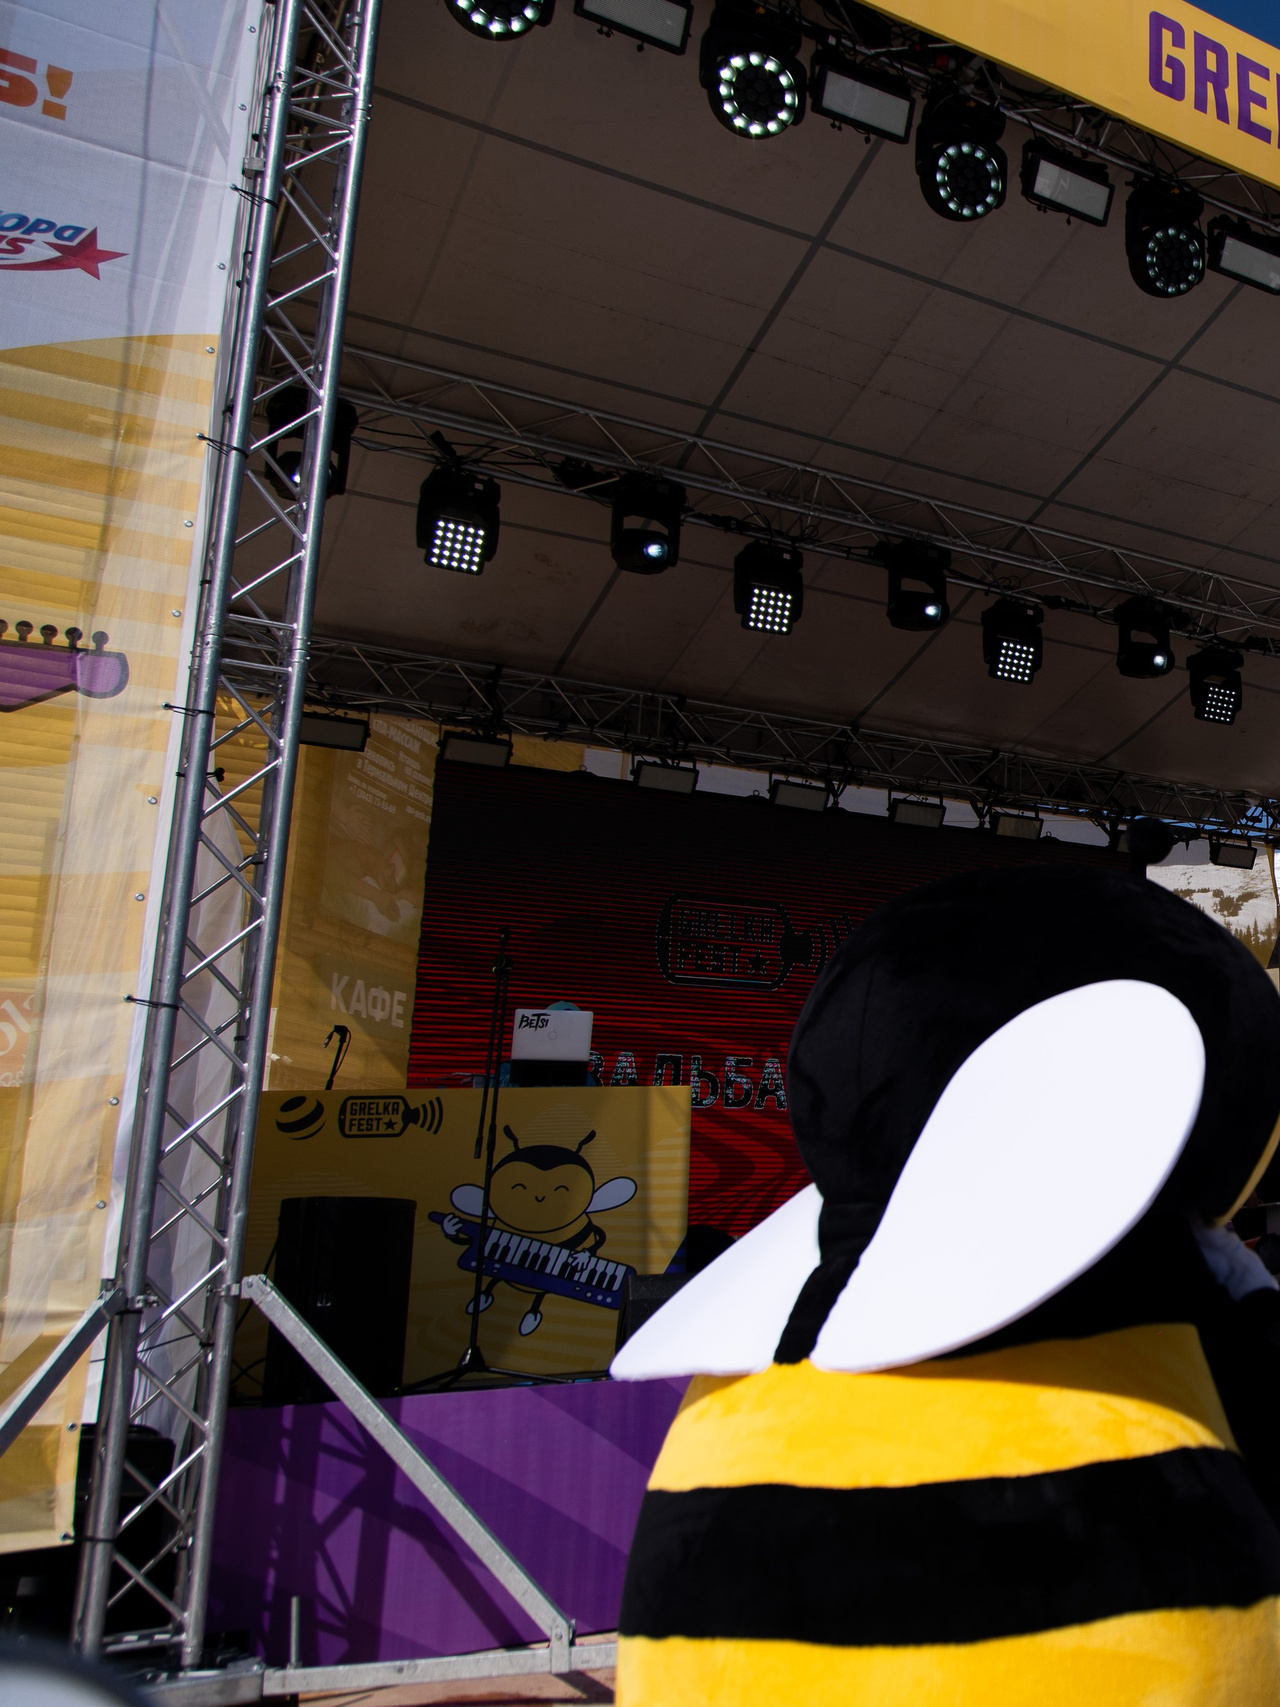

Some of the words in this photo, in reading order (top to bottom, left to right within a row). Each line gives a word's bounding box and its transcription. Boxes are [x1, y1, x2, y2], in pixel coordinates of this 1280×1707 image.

[331, 972, 407, 1029] КАФЕ
[350, 1102, 400, 1116] GRELKA
[348, 1117, 383, 1132] FEST
